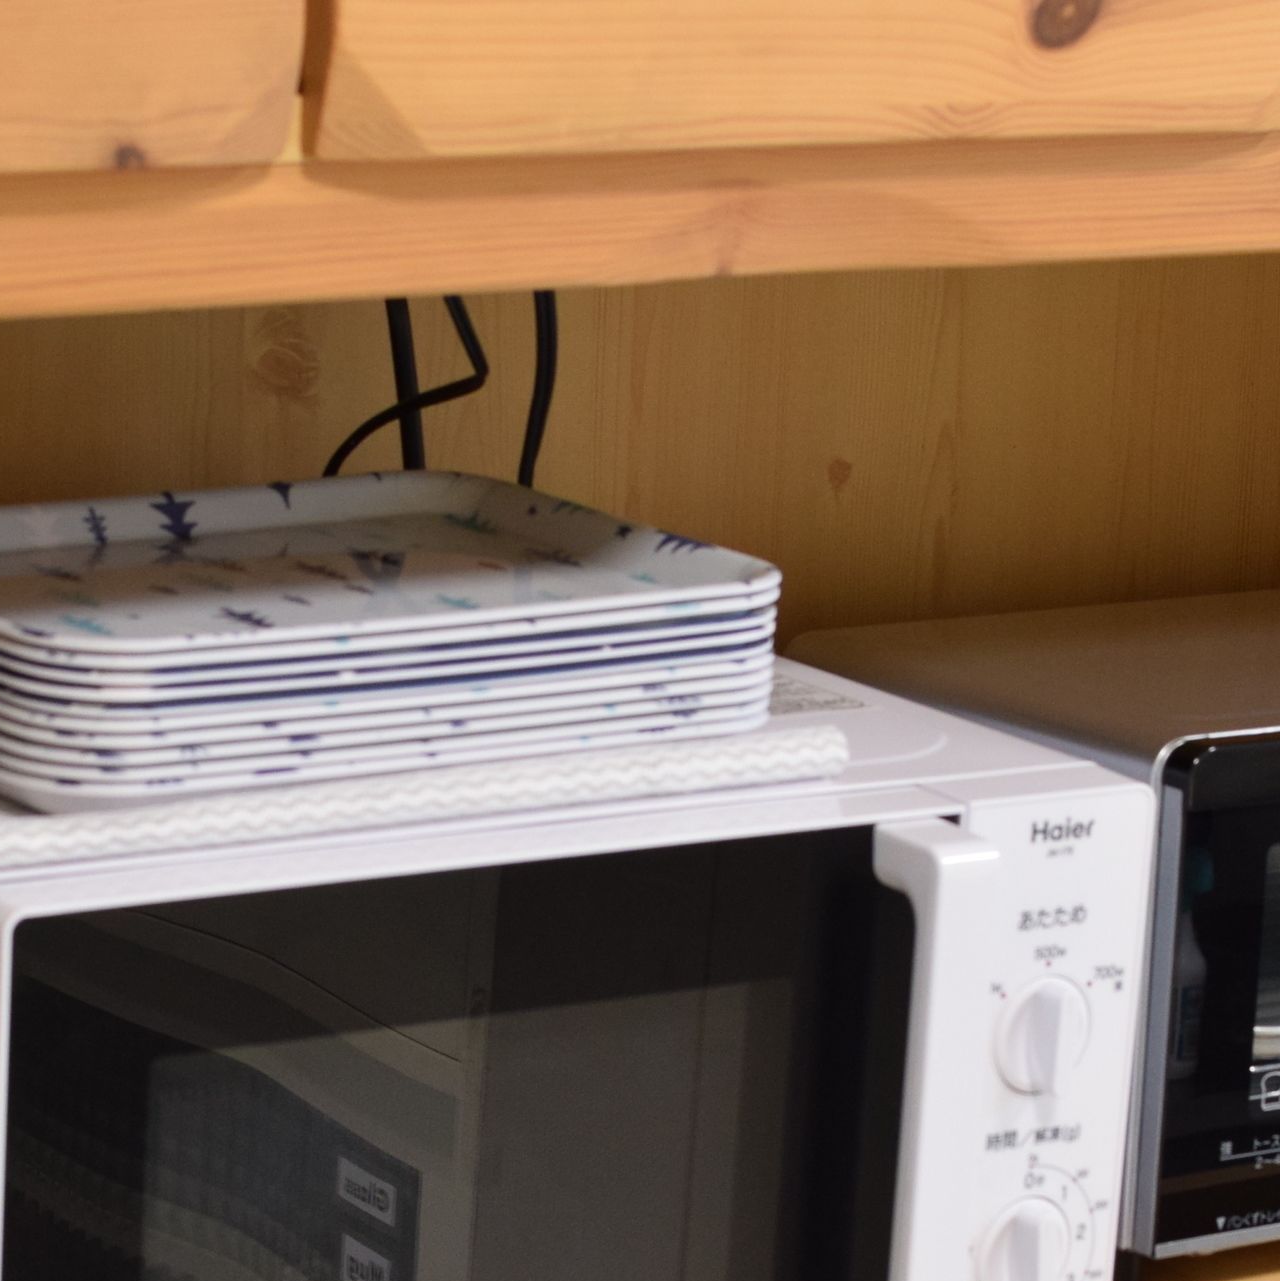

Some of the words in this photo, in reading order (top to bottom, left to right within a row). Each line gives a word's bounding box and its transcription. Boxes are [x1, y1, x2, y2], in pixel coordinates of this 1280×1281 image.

[1029, 816, 1096, 844] Haier
[1018, 903, 1087, 932] あたため
